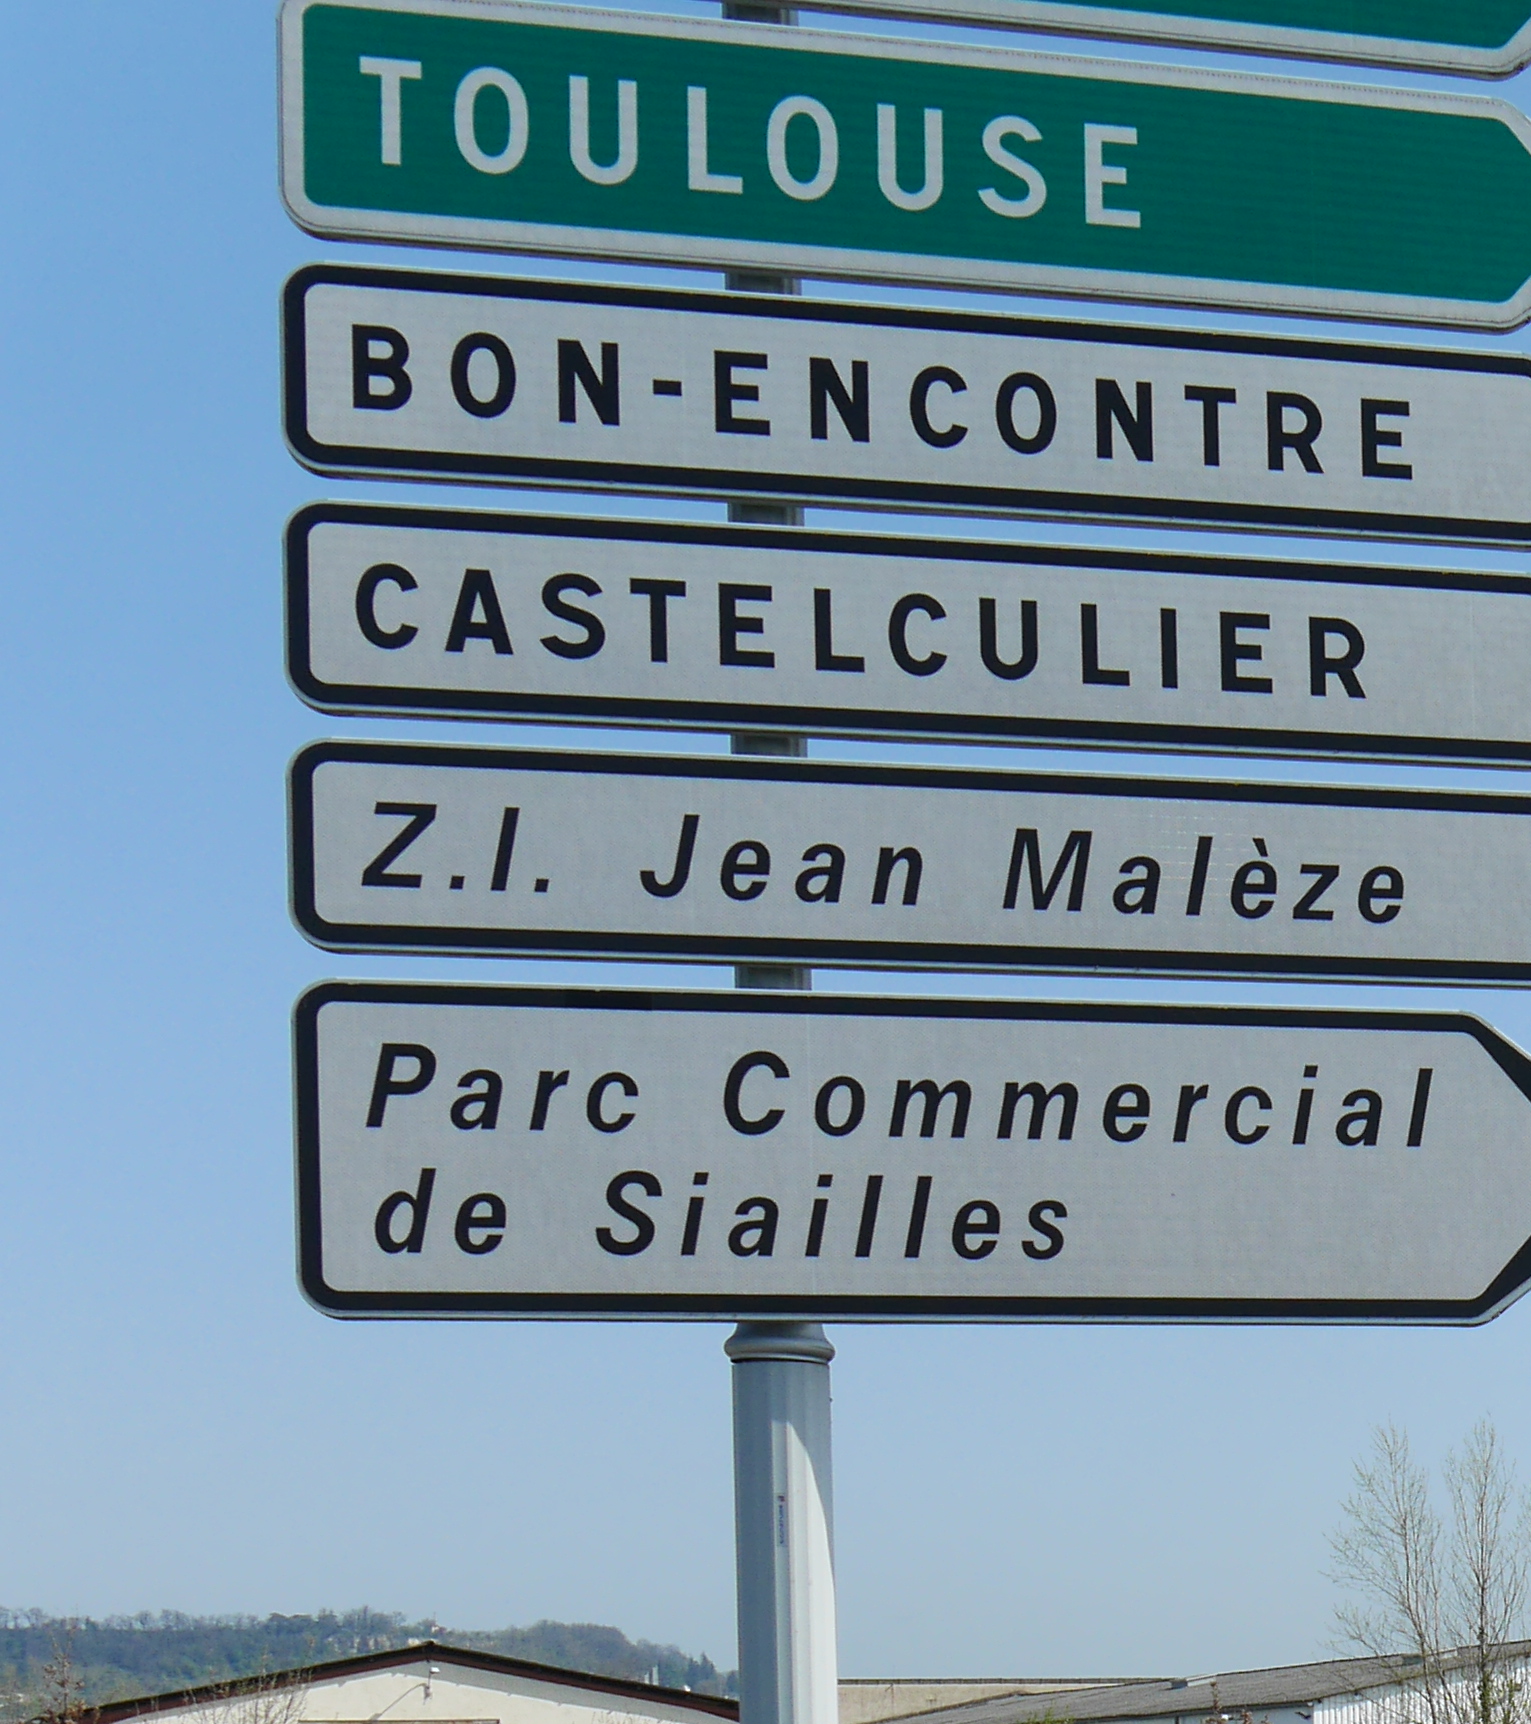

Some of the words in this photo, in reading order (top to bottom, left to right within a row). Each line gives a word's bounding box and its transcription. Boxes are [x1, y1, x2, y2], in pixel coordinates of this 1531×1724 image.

[360, 56, 1141, 229] TOULOUSE
[352, 324, 1413, 481] BON-ENCONTRE
[356, 564, 1367, 699] CASTELCULIER
[362, 802, 549, 892] Z.I.
[640, 815, 922, 905] Jean
[1003, 828, 1405, 924] Malèze
[366, 1043, 638, 1133] Parc
[724, 1051, 1433, 1147] Commercial
[375, 1168, 506, 1255] de
[596, 1171, 1067, 1260] Siailles
